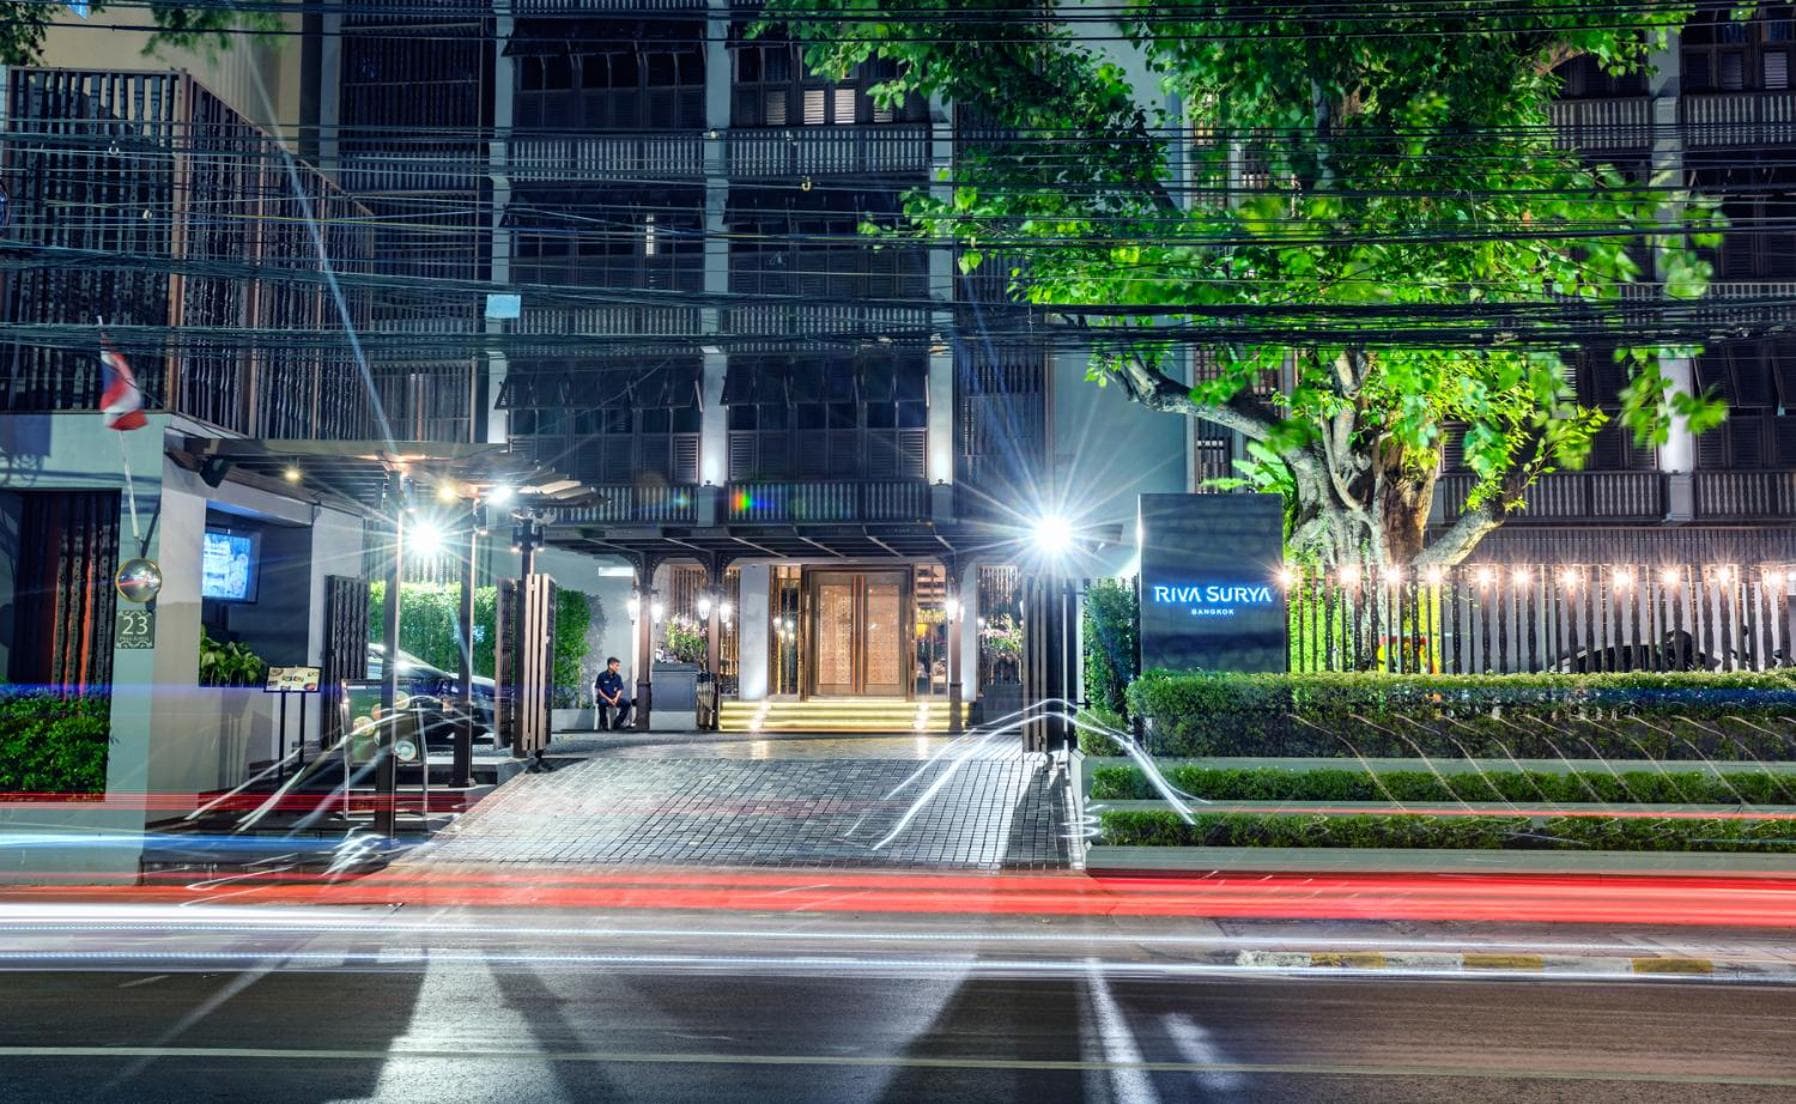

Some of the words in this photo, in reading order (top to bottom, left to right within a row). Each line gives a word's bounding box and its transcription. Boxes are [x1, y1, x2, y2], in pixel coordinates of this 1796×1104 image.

[1154, 586, 1202, 602] RIVA
[1206, 586, 1272, 602] SURYA
[1191, 608, 1235, 616] BANGKOK
[122, 616, 148, 635] 23
